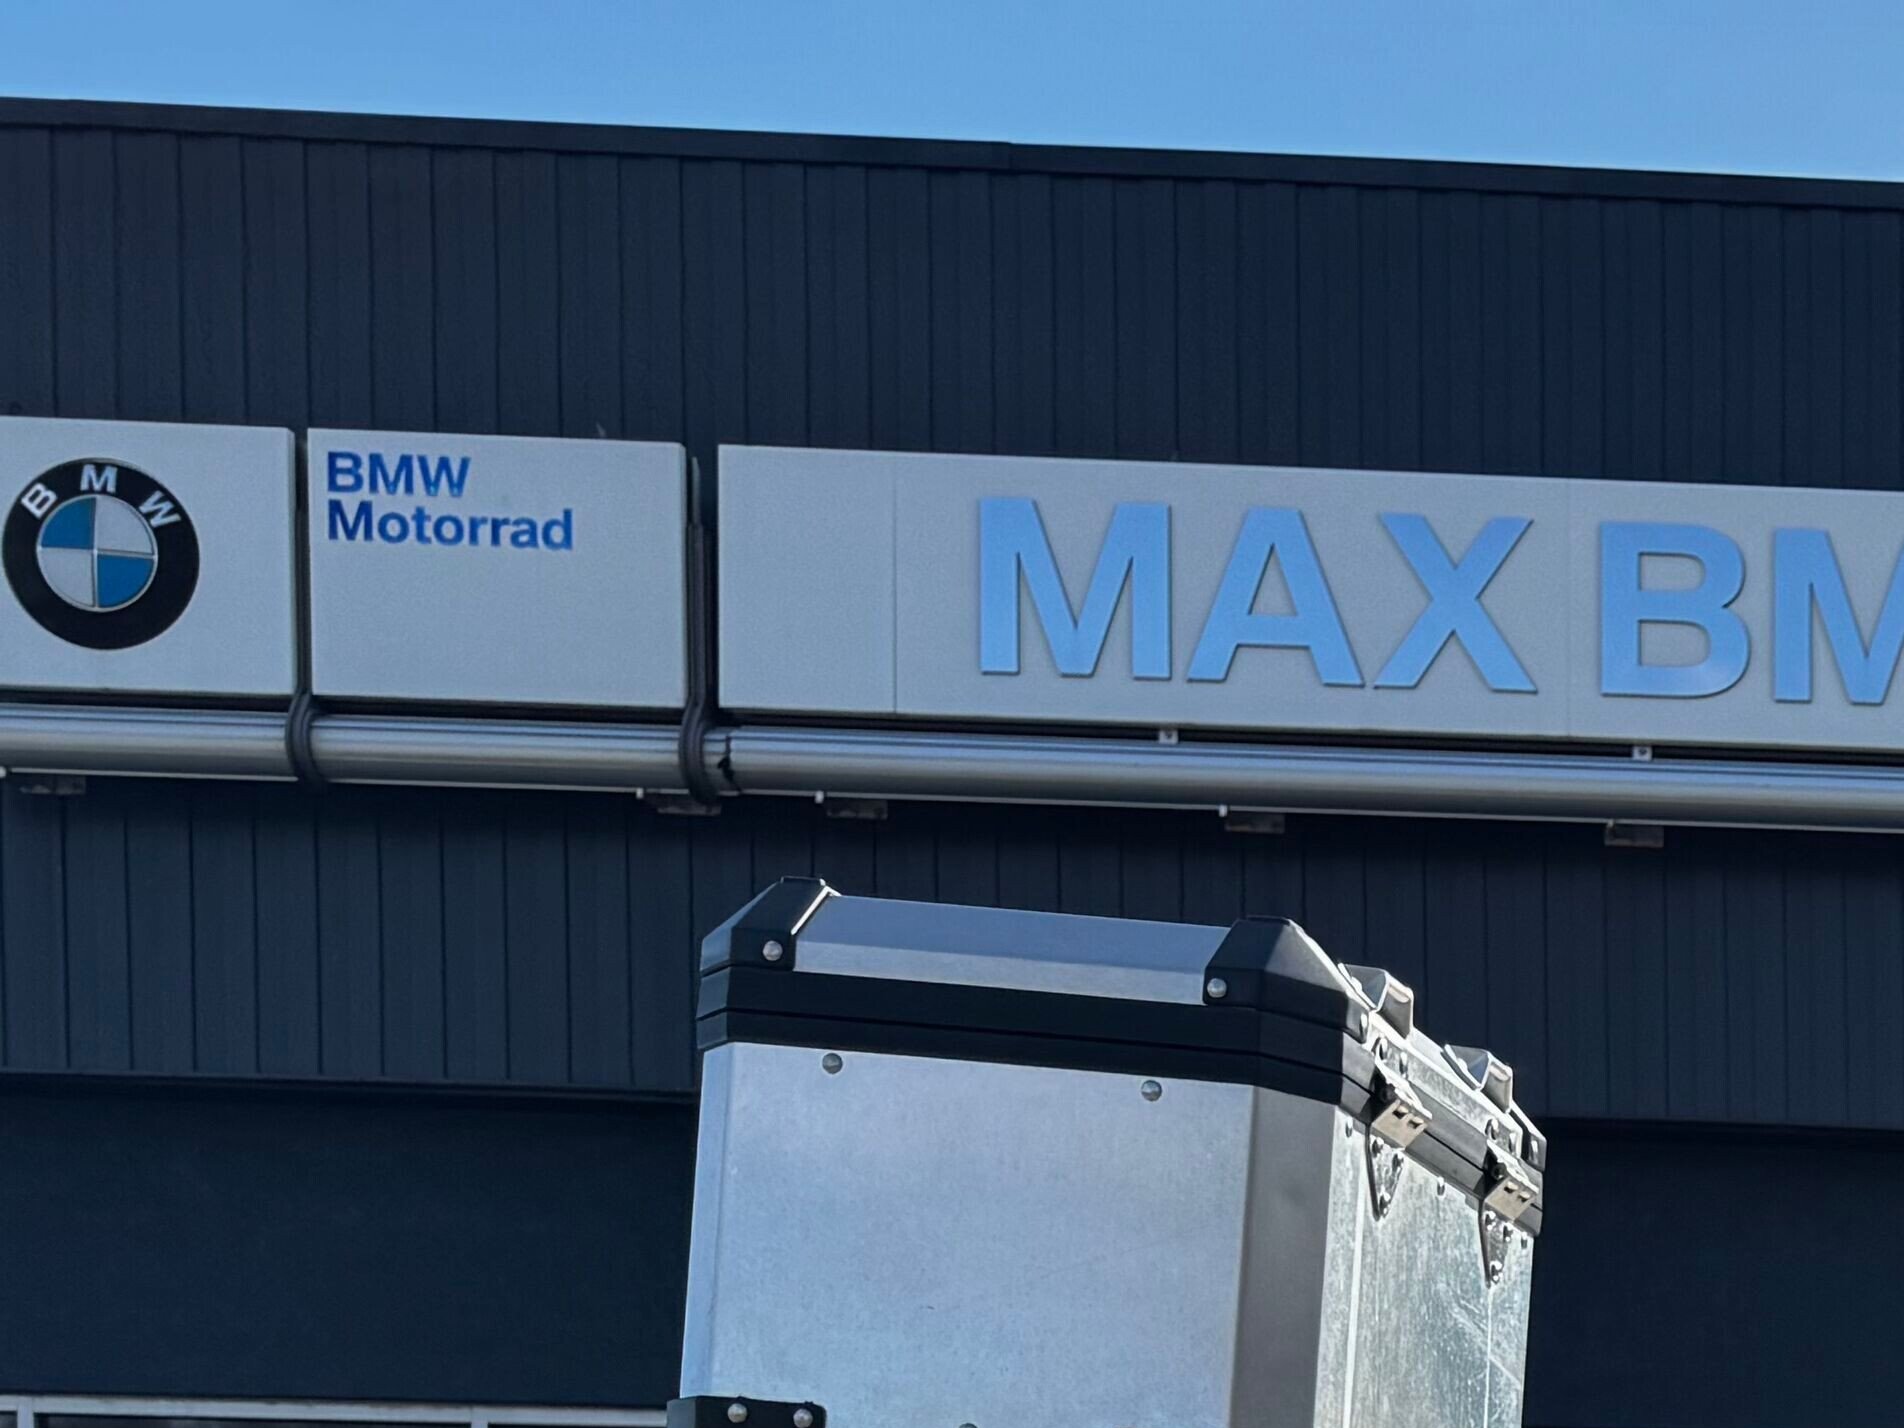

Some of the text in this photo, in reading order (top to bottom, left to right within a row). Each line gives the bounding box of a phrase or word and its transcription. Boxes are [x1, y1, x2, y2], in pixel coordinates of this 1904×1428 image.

[20, 463, 182, 530] BMW
[325, 451, 471, 498] BMW
[327, 500, 573, 551] Motorrad
[978, 497, 1538, 694] MAX
